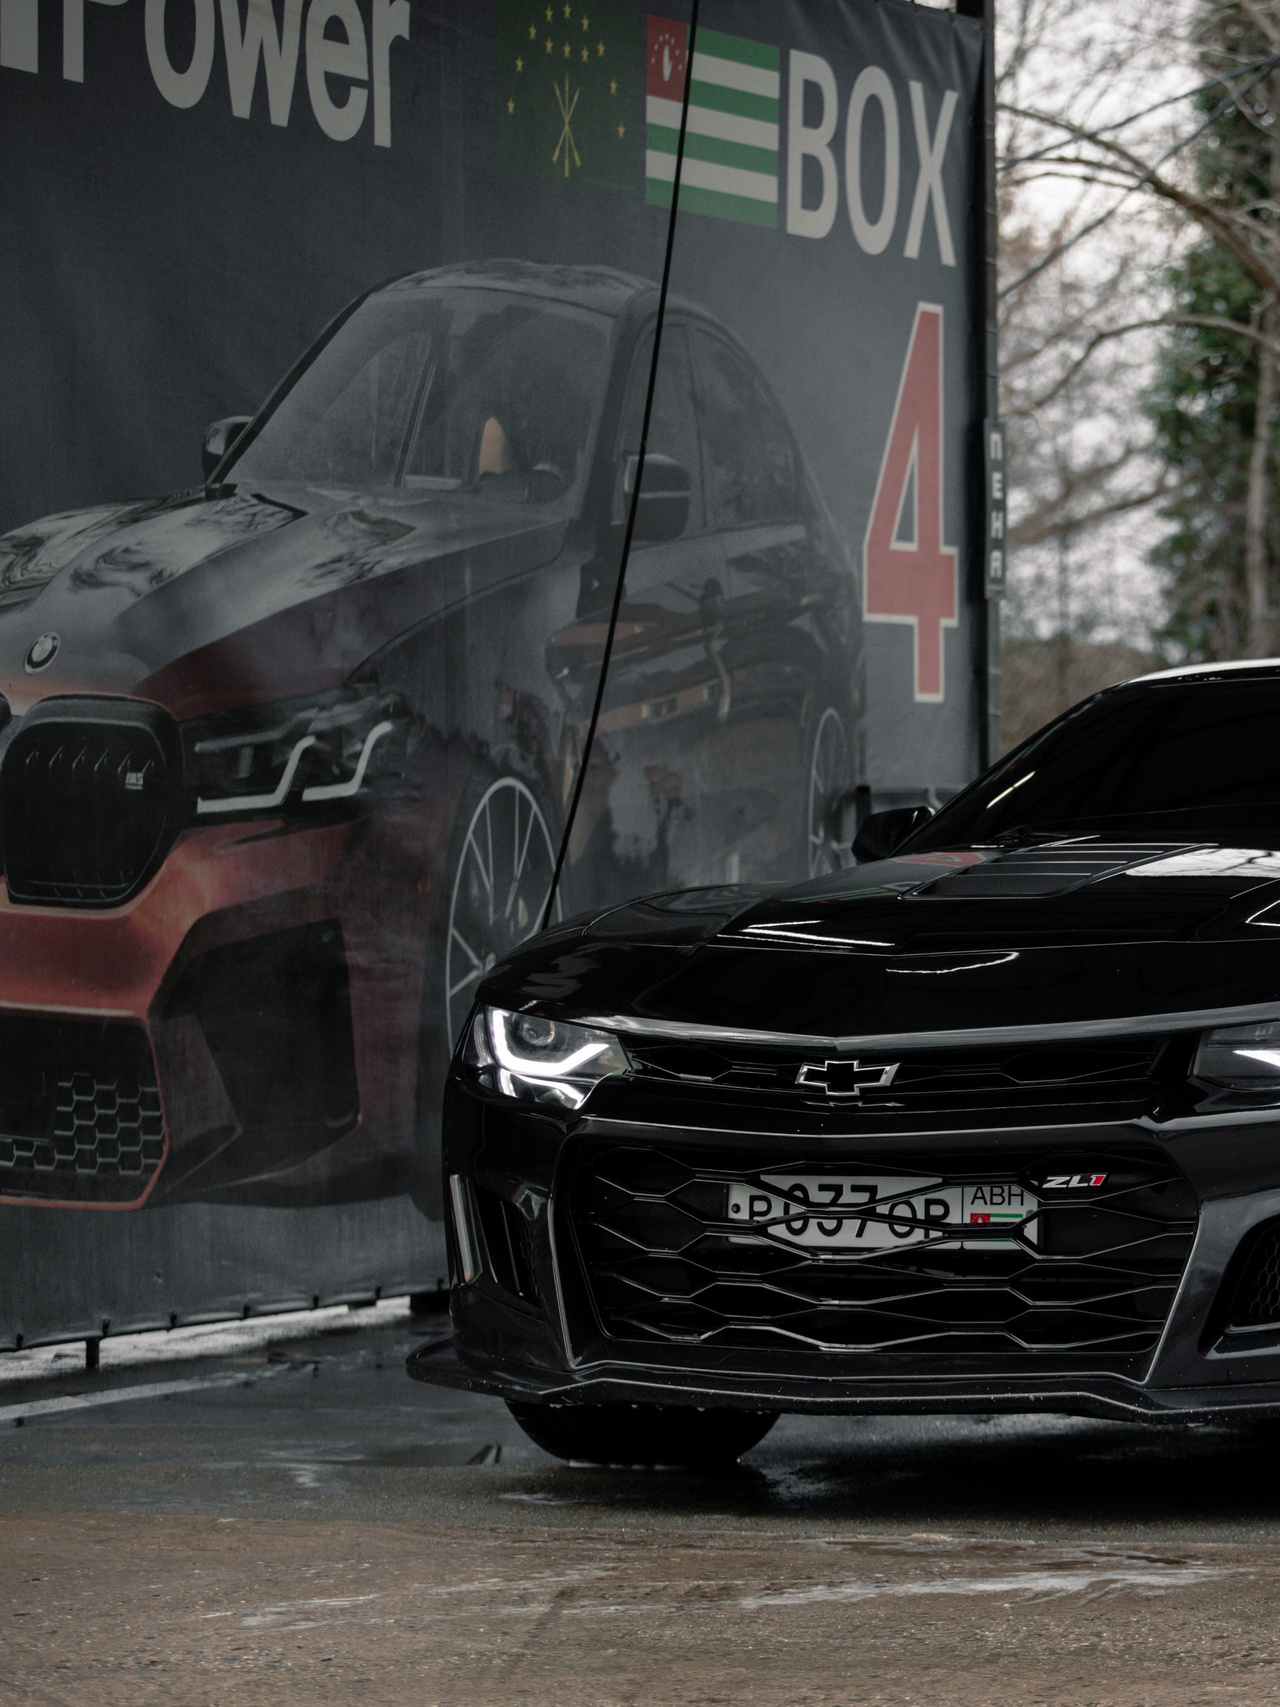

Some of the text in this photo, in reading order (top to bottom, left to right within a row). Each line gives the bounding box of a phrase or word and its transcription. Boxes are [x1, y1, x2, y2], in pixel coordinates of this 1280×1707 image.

[786, 48, 959, 267] BOX
[863, 302, 959, 703] 4
[970, 1185, 1024, 1206] ABH
[1042, 1174, 1107, 1189] ZL1
